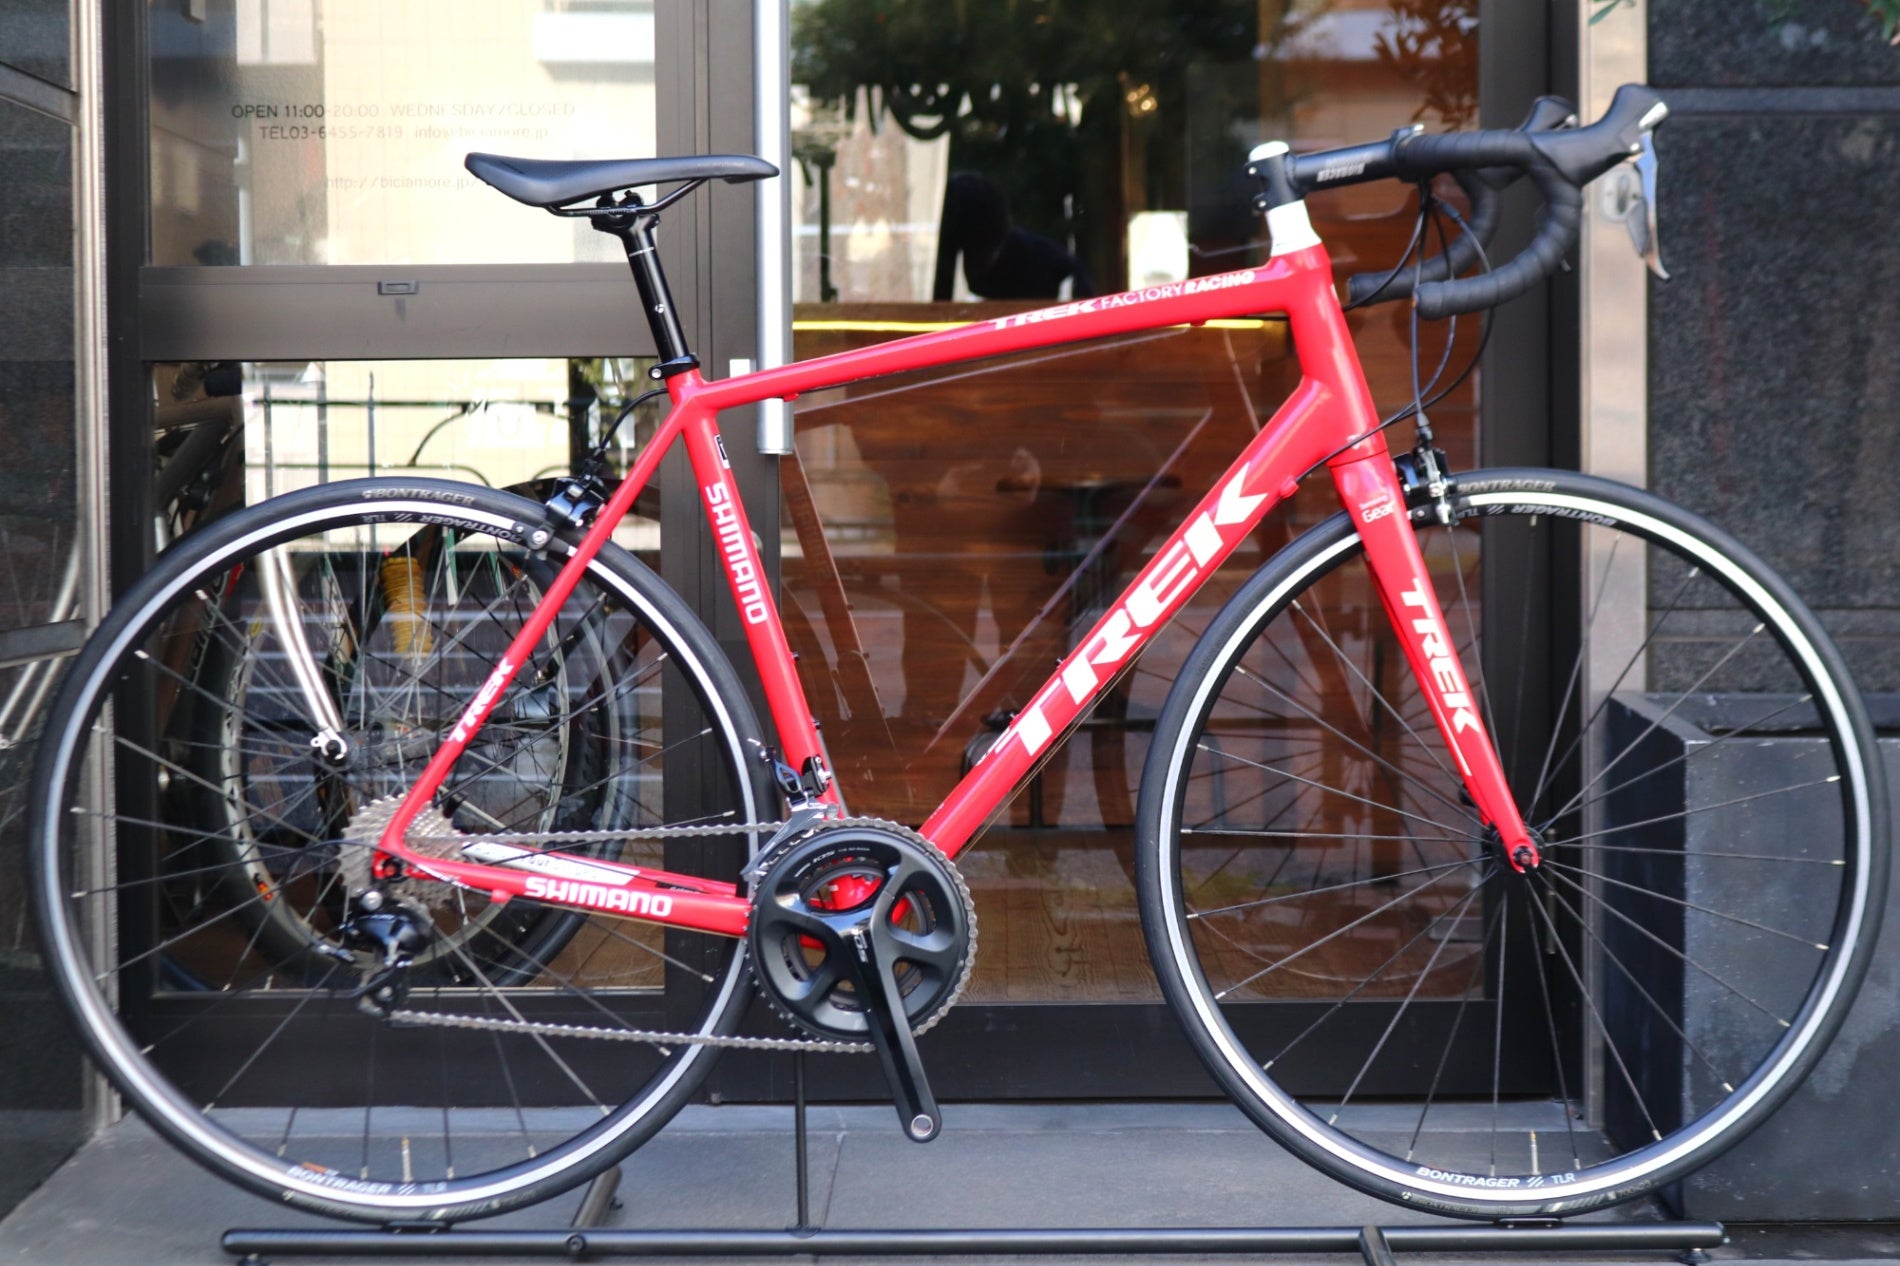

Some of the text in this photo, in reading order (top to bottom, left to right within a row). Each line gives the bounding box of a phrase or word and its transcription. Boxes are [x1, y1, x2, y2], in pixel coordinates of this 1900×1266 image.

[231, 104, 278, 118] OPEN
[989, 271, 1255, 330] TREK FACTORY RACING
[375, 487, 475, 506] BONTRAGER
[1457, 479, 1556, 494] BONTRAGER
[1362, 502, 1395, 524] Gear
[1511, 503, 1618, 526] BONTRAGER
[705, 481, 768, 624] SHIMANO
[995, 461, 1268, 756] TREK
[1401, 577, 1481, 734] TREK
[448, 657, 515, 742] TREK
[524, 876, 673, 917] SHIMANO
[287, 1165, 393, 1194] BONTRAGER
[1417, 1167, 1576, 1188] BONTRAGER TLR
